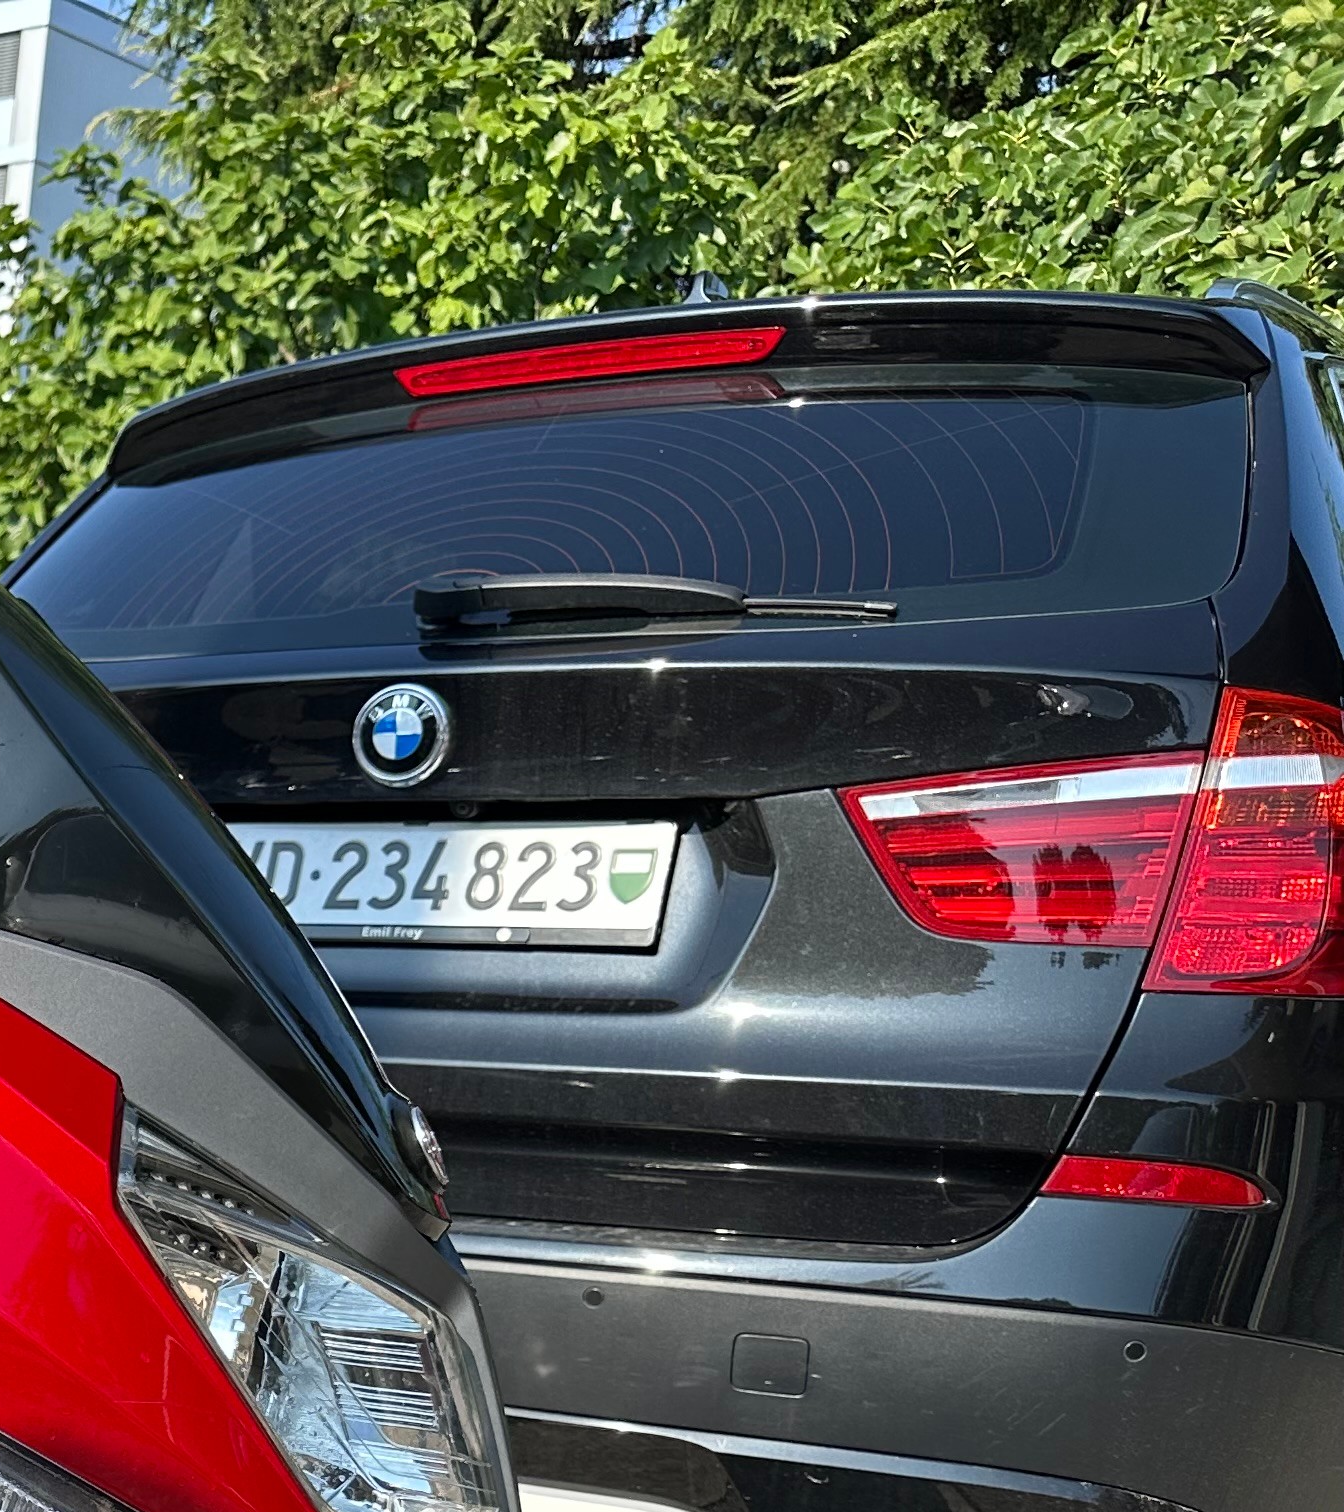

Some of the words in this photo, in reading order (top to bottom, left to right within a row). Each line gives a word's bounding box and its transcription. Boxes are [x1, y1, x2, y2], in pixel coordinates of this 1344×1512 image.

[369, 694, 434, 723] BMW
[465, 840, 602, 912] 823
[361, 926, 392, 938] Emil
[393, 926, 424, 941] Frey
